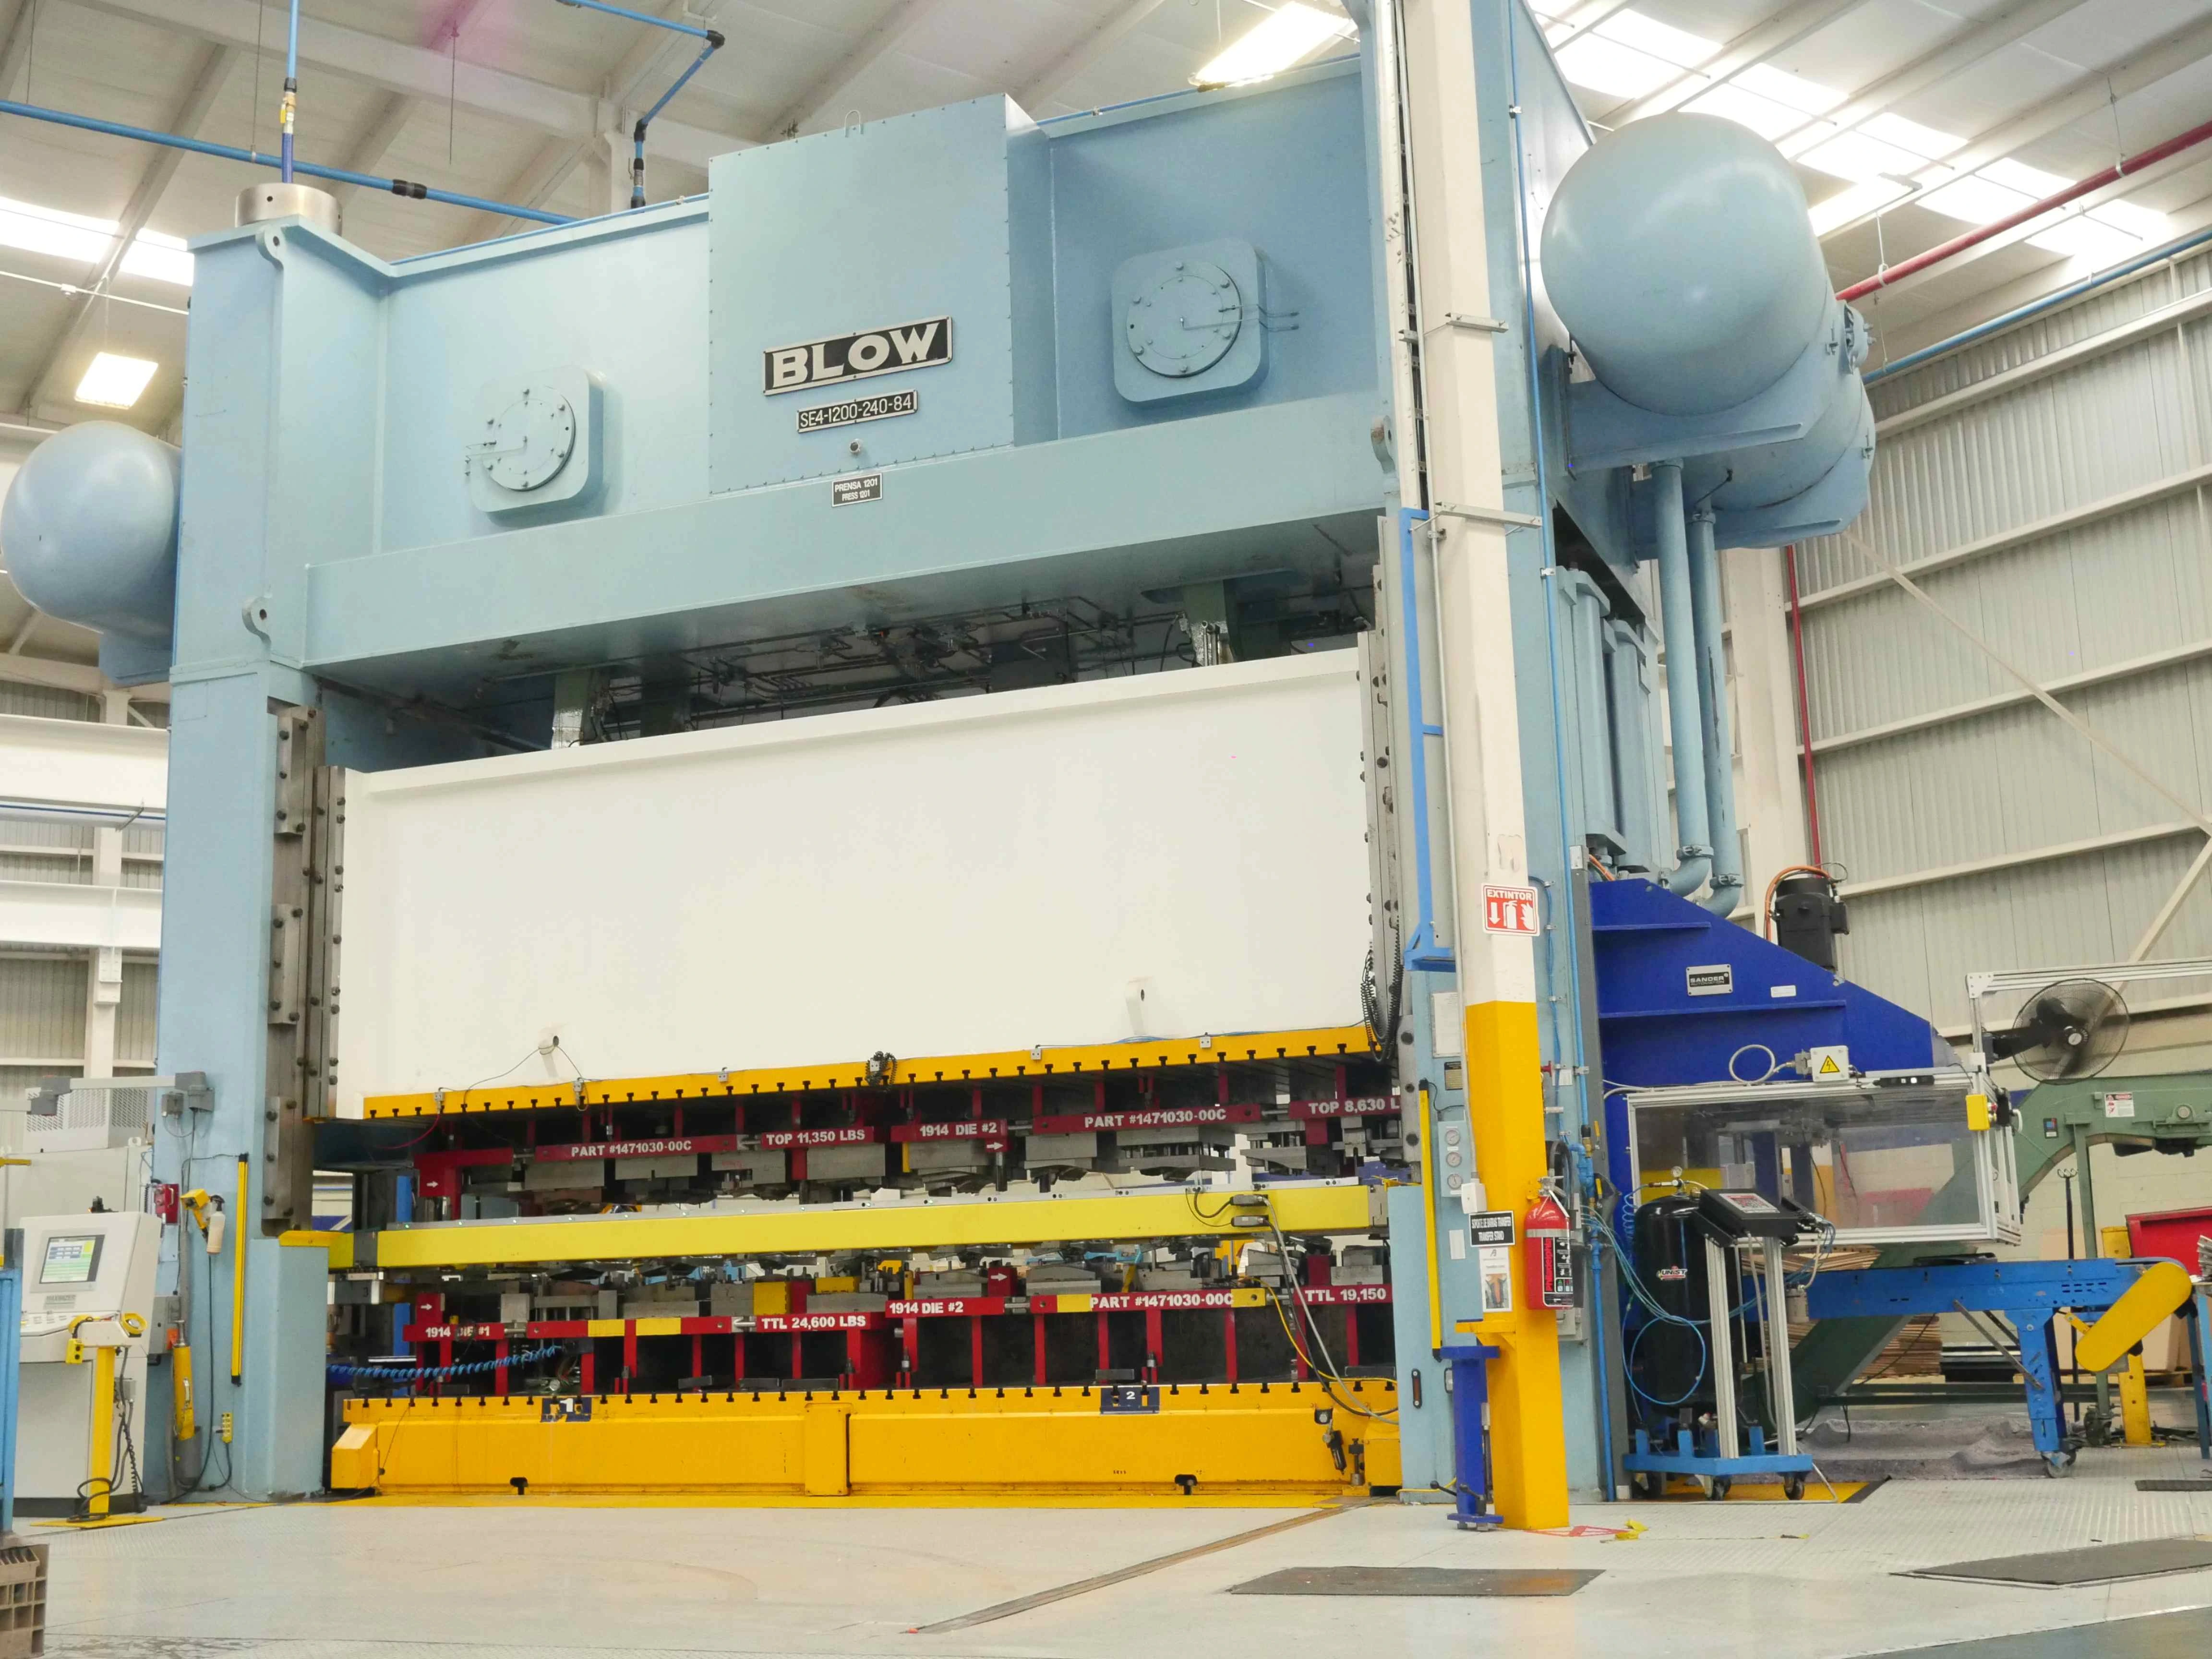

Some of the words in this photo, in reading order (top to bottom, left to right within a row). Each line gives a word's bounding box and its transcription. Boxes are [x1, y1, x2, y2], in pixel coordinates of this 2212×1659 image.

[772, 323, 940, 388] BLOW
[800, 395, 912, 428] SE4-1200-240-84
[834, 481, 861, 493] PRENSA
[864, 478, 878, 488] 1201
[842, 491, 858, 501] PRESS
[859, 490, 870, 498] 1201
[1487, 889, 1532, 901] EXTINTOR
[1309, 1101, 1339, 1114] TOP
[1345, 1098, 1385, 1113] 8,630
[1084, 1115, 1124, 1128] PART
[1130, 1108, 1226, 1125] #1471030-00C
[767, 1131, 793, 1145] TOP
[797, 1130, 836, 1144] 11,350
[839, 1128, 865, 1141] LBS
[920, 1124, 949, 1137] 1914
[956, 1123, 977, 1135] DIE
[982, 1122, 997, 1134] #2
[571, 1145, 604, 1157] PART
[609, 1140, 691, 1154] #1471030-00C
[1091, 1296, 1130, 1309] PART
[1134, 1293, 1233, 1307] #1471030-00C
[1305, 1289, 1334, 1302] TTL
[1340, 1288, 1386, 1303] 19,150
[890, 1302, 919, 1314] 1914
[922, 1302, 943, 1314] DIE
[948, 1301, 963, 1313] #2
[761, 1317, 787, 1330] TTL
[792, 1317, 835, 1330] 24,600
[840, 1315, 866, 1327] LBS
[425, 1326, 451, 1338] 1914
[478, 1326, 490, 1336] #1
[1126, 1391, 1136, 1399] 2
[560, 1398, 573, 1412] 1
